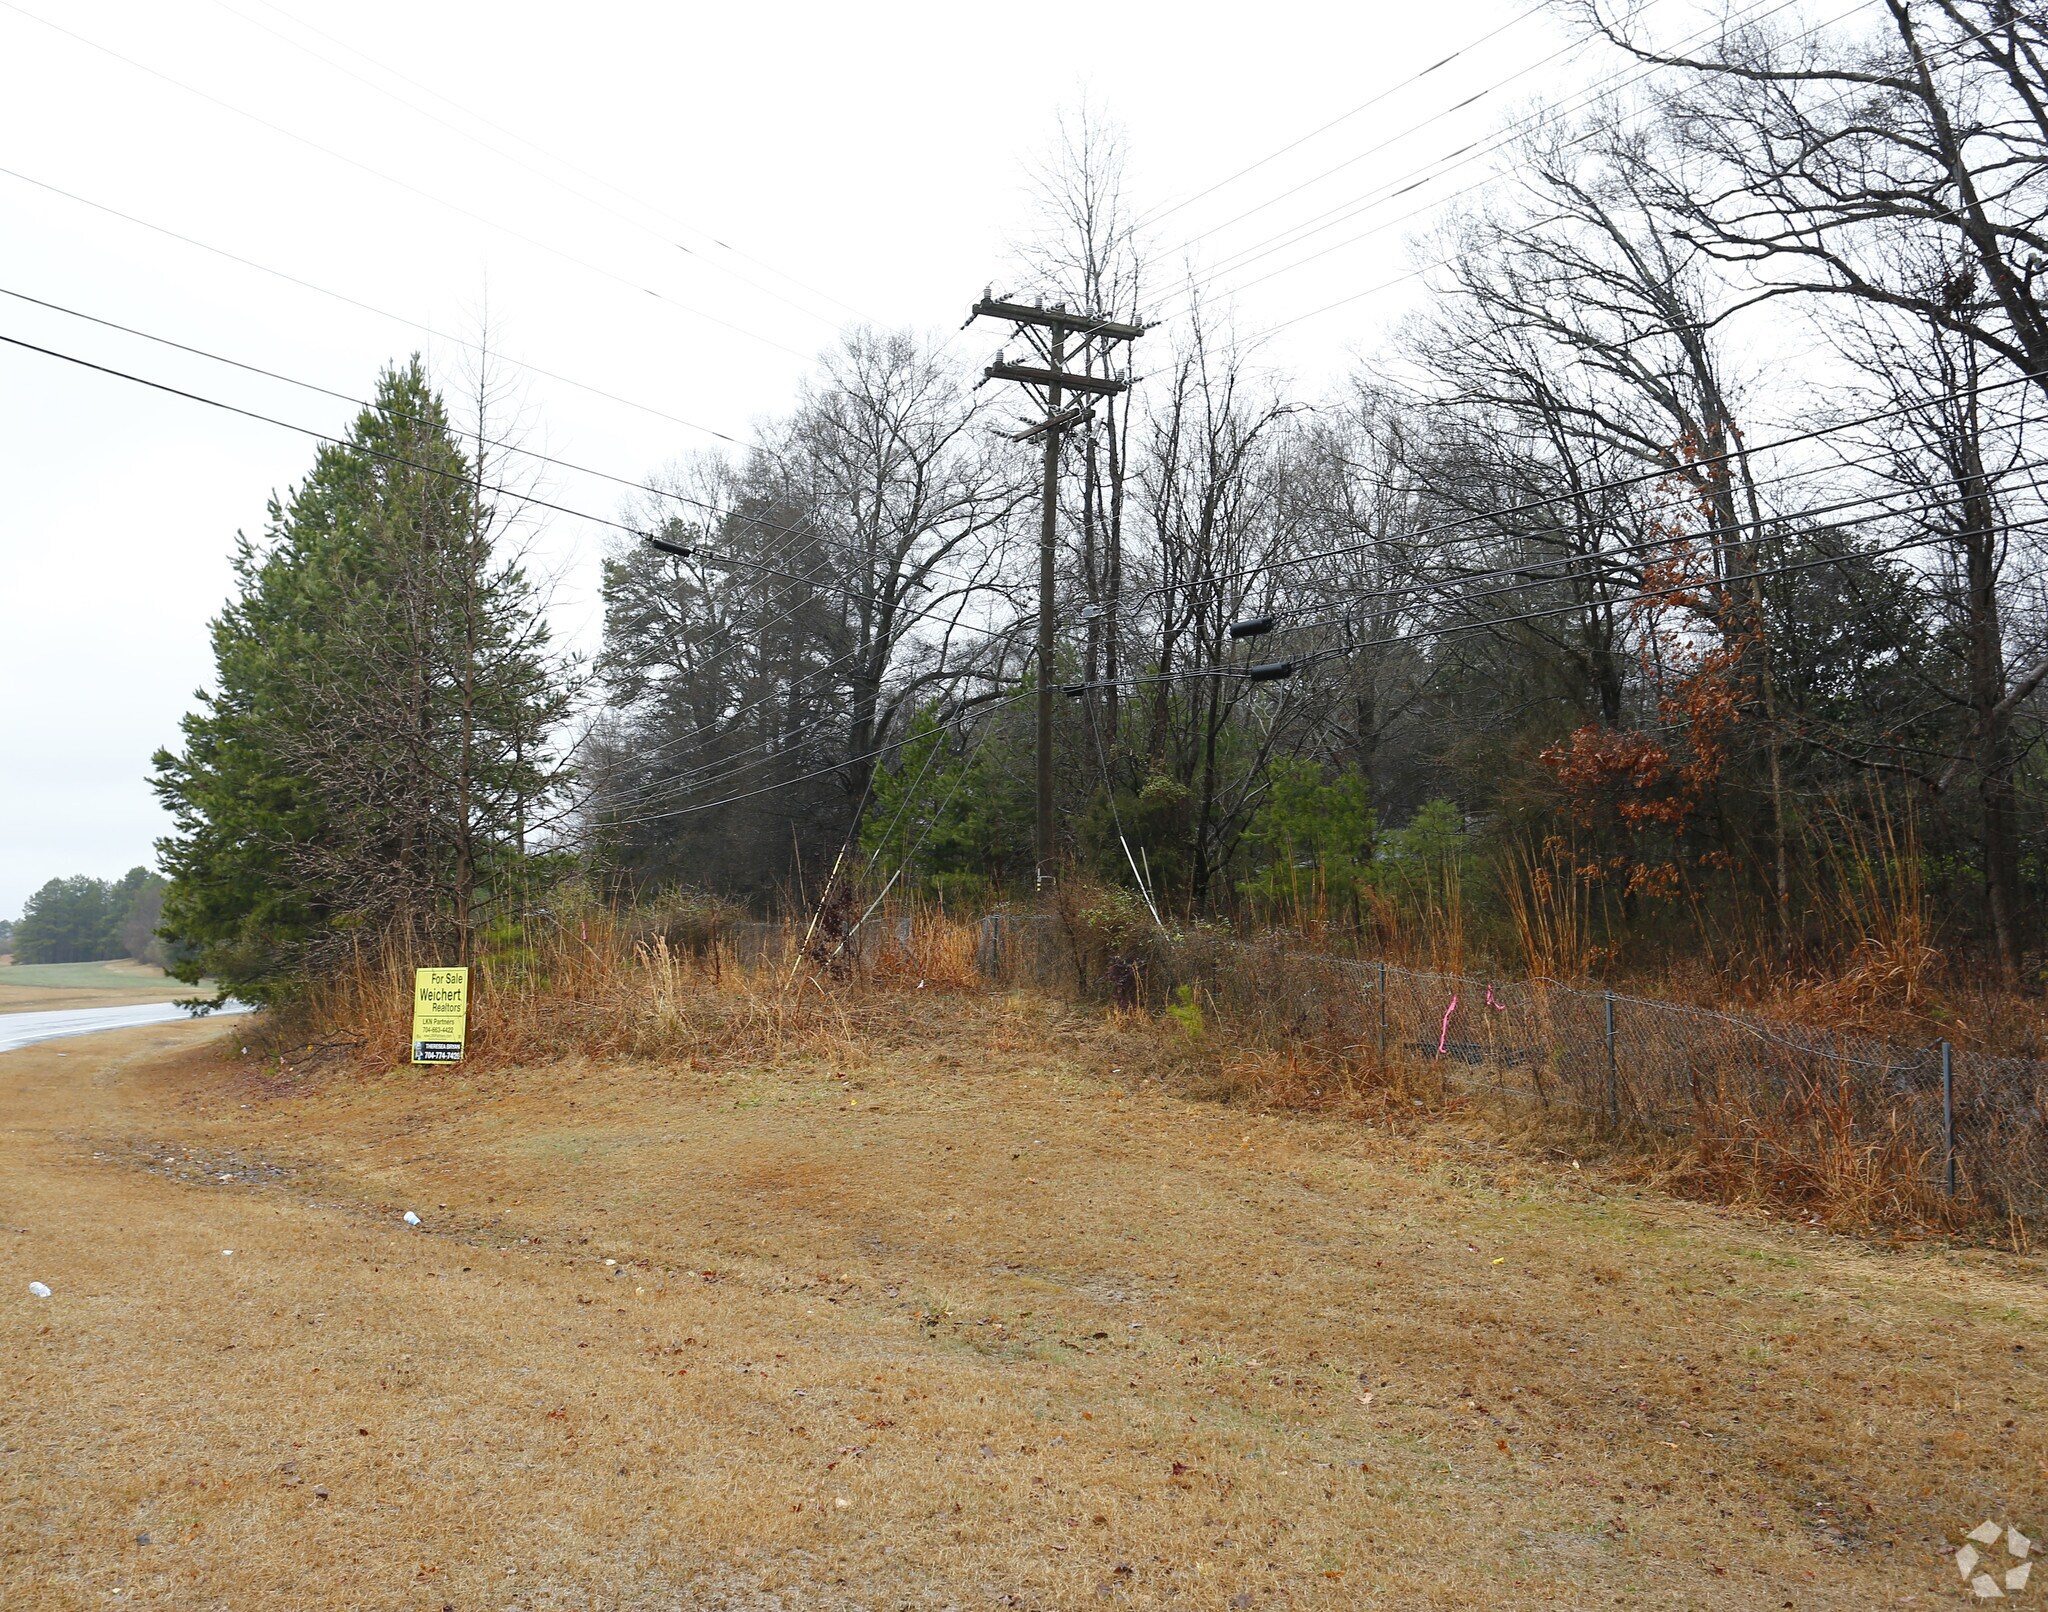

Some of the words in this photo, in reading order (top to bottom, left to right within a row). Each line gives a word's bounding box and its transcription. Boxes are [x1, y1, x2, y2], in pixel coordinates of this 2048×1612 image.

[432, 974, 444, 984] For
[445, 973, 463, 984] Sale
[420, 988, 461, 1001] Weichert
[432, 1003, 461, 1012] Realtors
